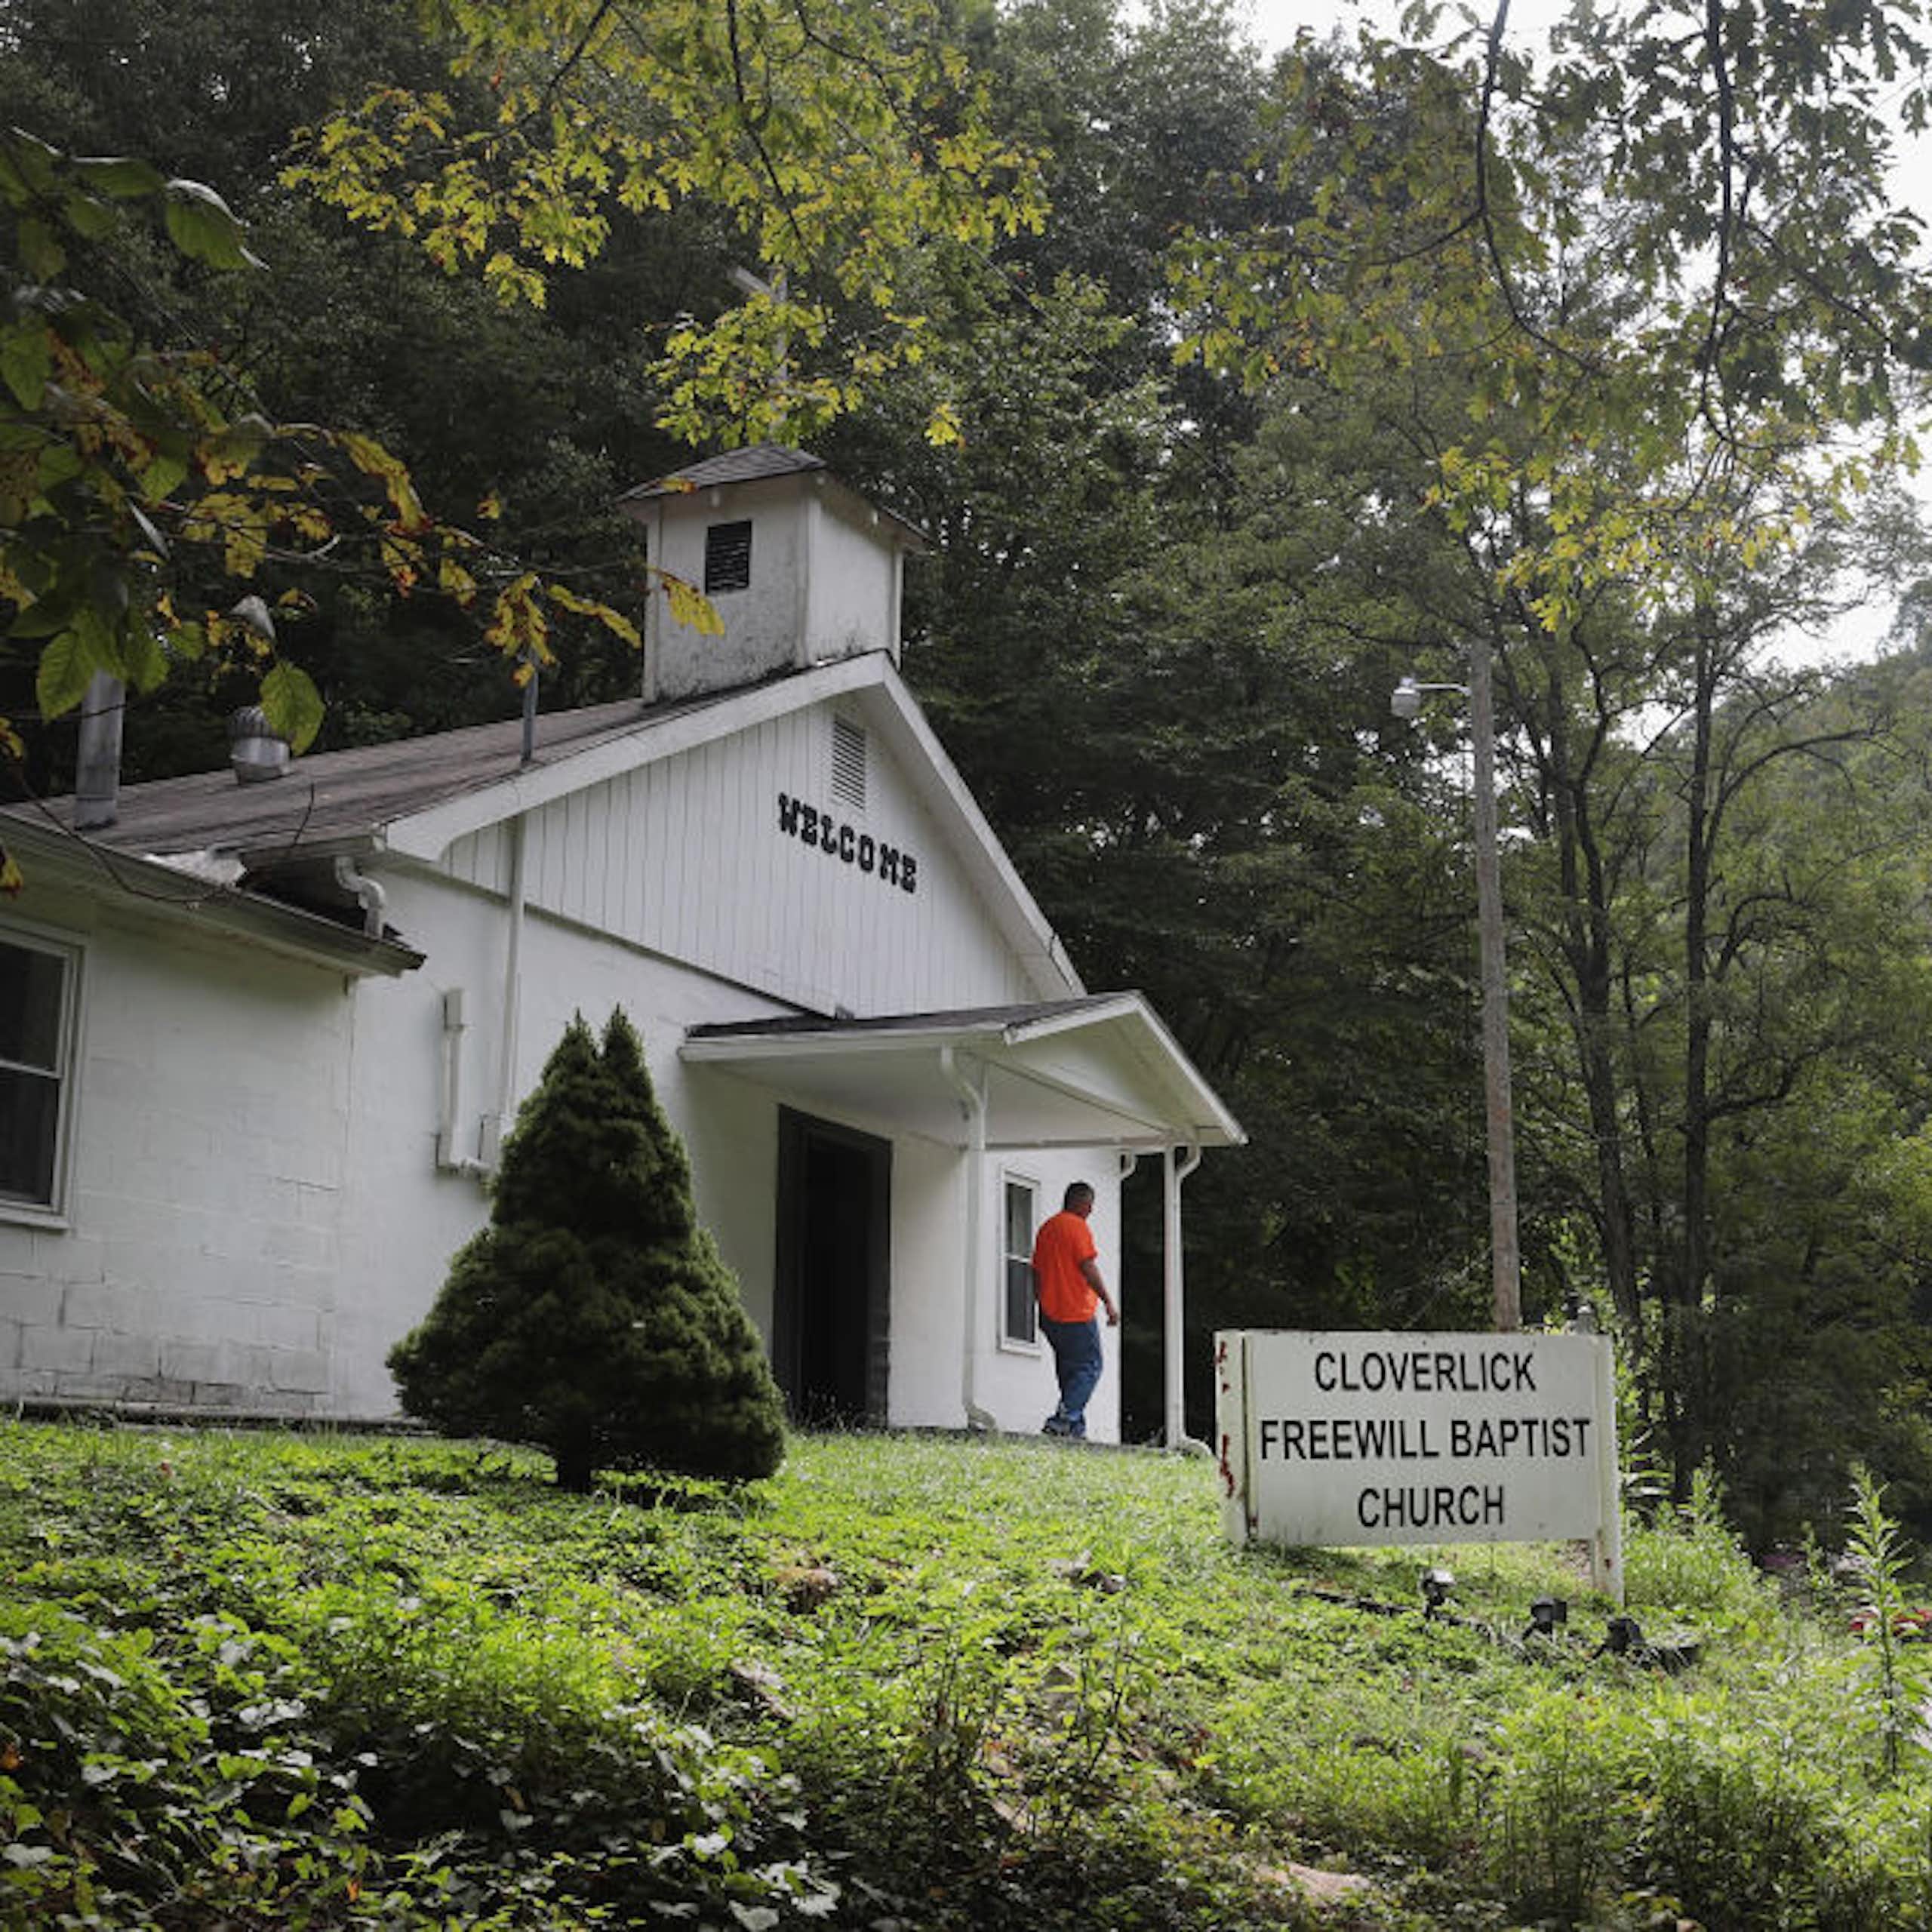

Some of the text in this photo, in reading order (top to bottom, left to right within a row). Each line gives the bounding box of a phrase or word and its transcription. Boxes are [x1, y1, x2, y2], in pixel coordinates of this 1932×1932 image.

[779, 792, 916, 894] WELCOME
[1315, 1352, 1537, 1391] CLOVERLICK
[1260, 1418, 1591, 1460] FREEWILL BAPTIST
[1358, 1484, 1504, 1528] CHURCH
